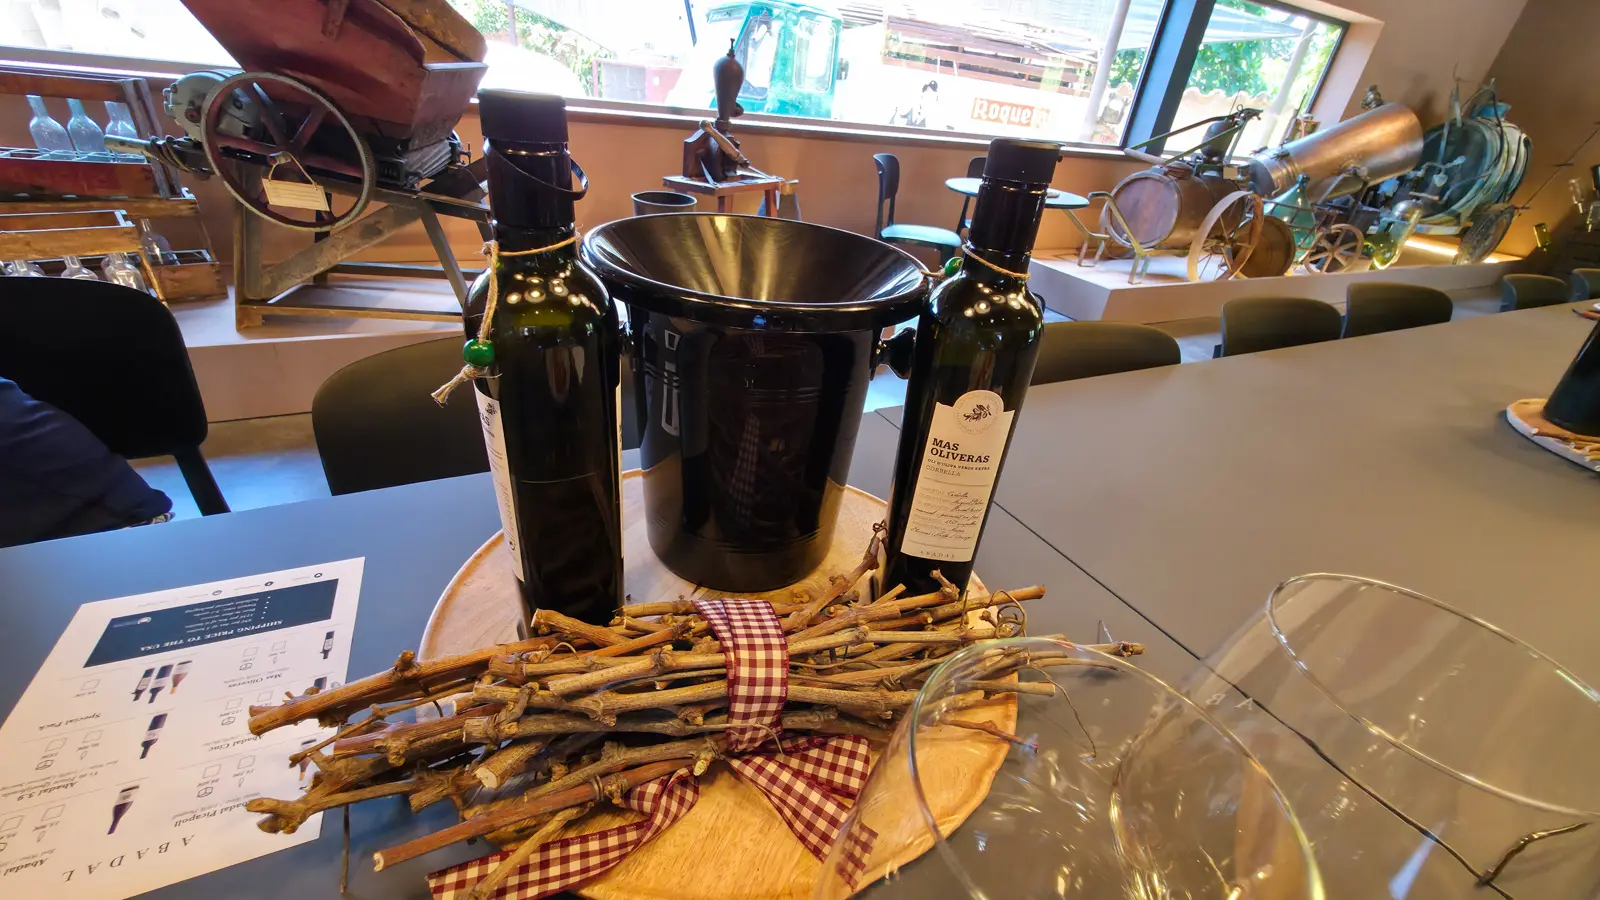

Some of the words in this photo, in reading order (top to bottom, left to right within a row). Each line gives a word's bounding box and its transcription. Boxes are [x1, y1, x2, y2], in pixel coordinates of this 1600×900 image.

[932, 438, 960, 451] MAS
[930, 447, 990, 463] OLIVERAS
[925, 464, 961, 477] CORBELLA
[237, 620, 282, 632] SHIPPING
[204, 630, 234, 638] PRICE
[139, 643, 161, 651] USA
[228, 678, 263, 688] Oliveras
[65, 713, 102, 725] Special
[37, 721, 63, 731] Pack
[37, 781, 79, 795] Abadal
[174, 809, 217, 827] Picapoll
[61, 835, 194, 882] ABADAL
[3, 858, 48, 876] Abadal
